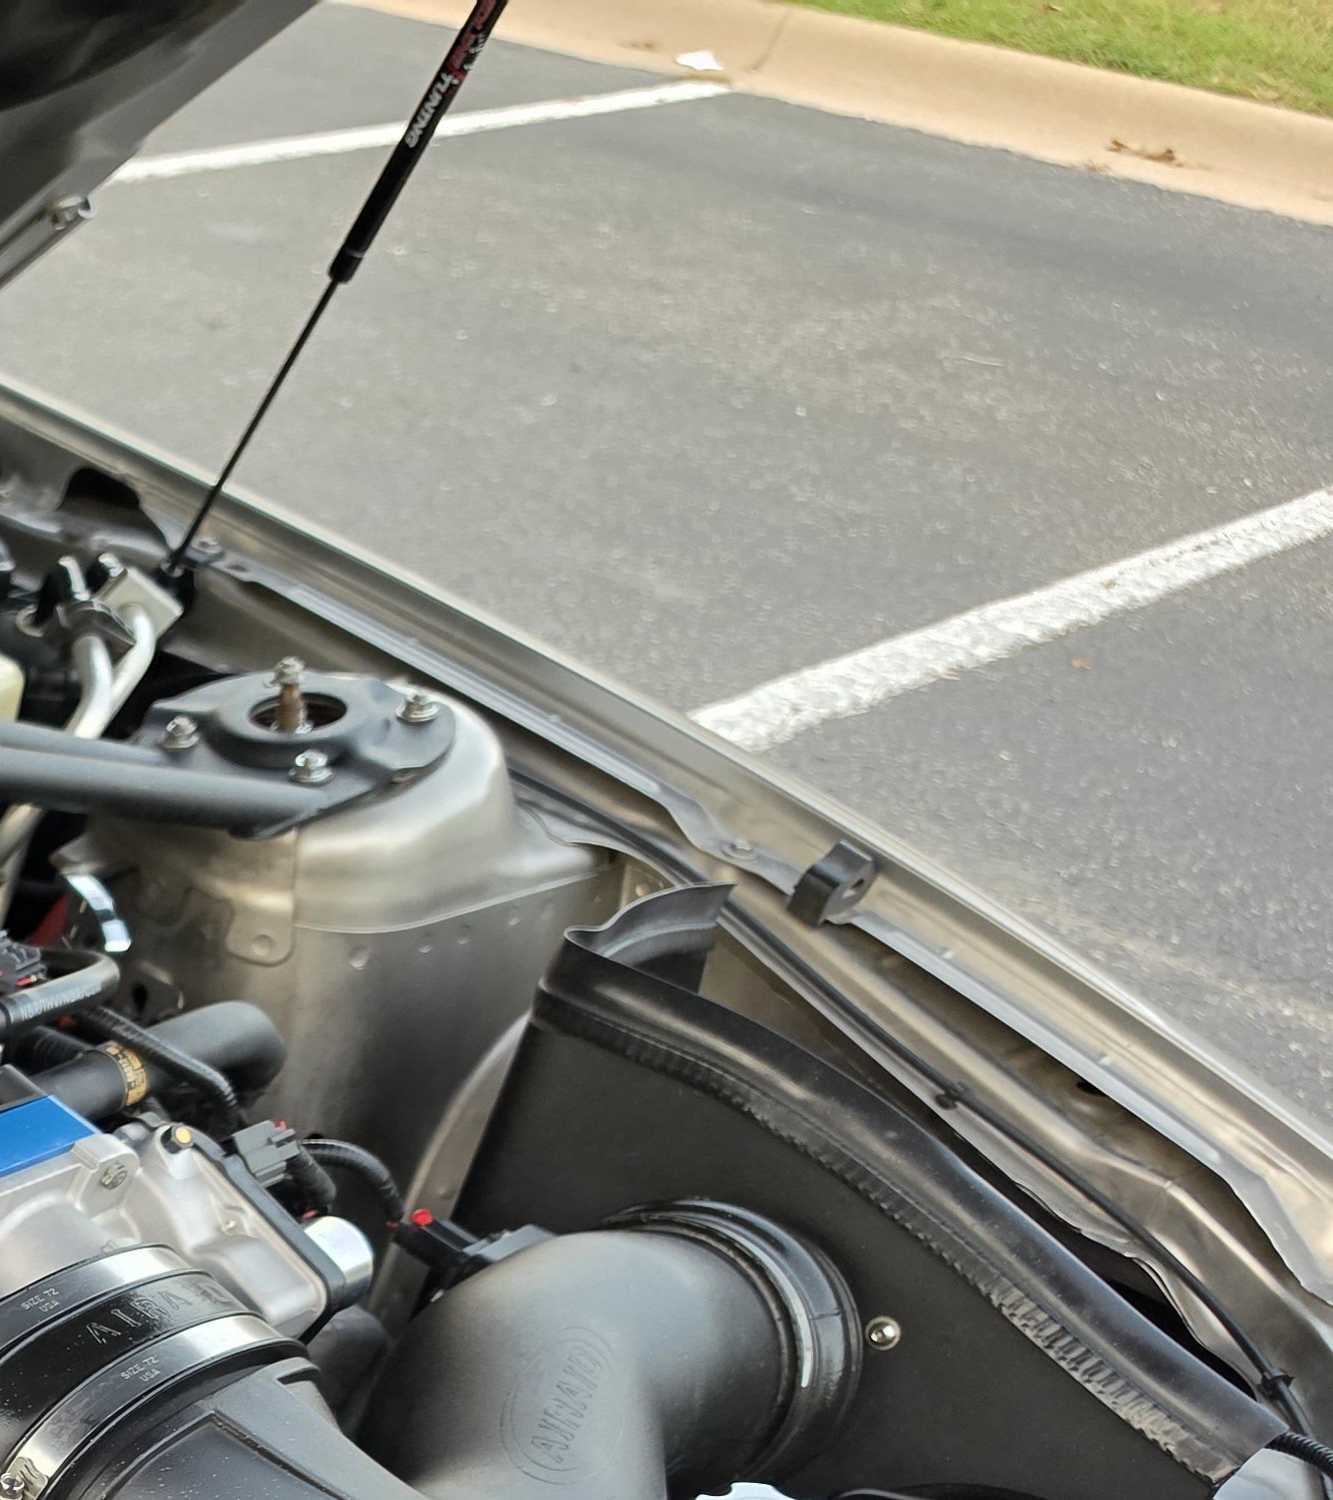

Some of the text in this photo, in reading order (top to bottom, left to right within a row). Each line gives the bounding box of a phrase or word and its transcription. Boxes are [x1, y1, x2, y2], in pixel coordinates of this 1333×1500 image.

[404, 72, 456, 148] TUNING
[21, 1287, 59, 1312] SIZE 72
[38, 1299, 60, 1313] USA
[121, 1355, 159, 1381] SIZE 72
[139, 1368, 160, 1383] USA
[529, 1348, 605, 1466] AIRAID
